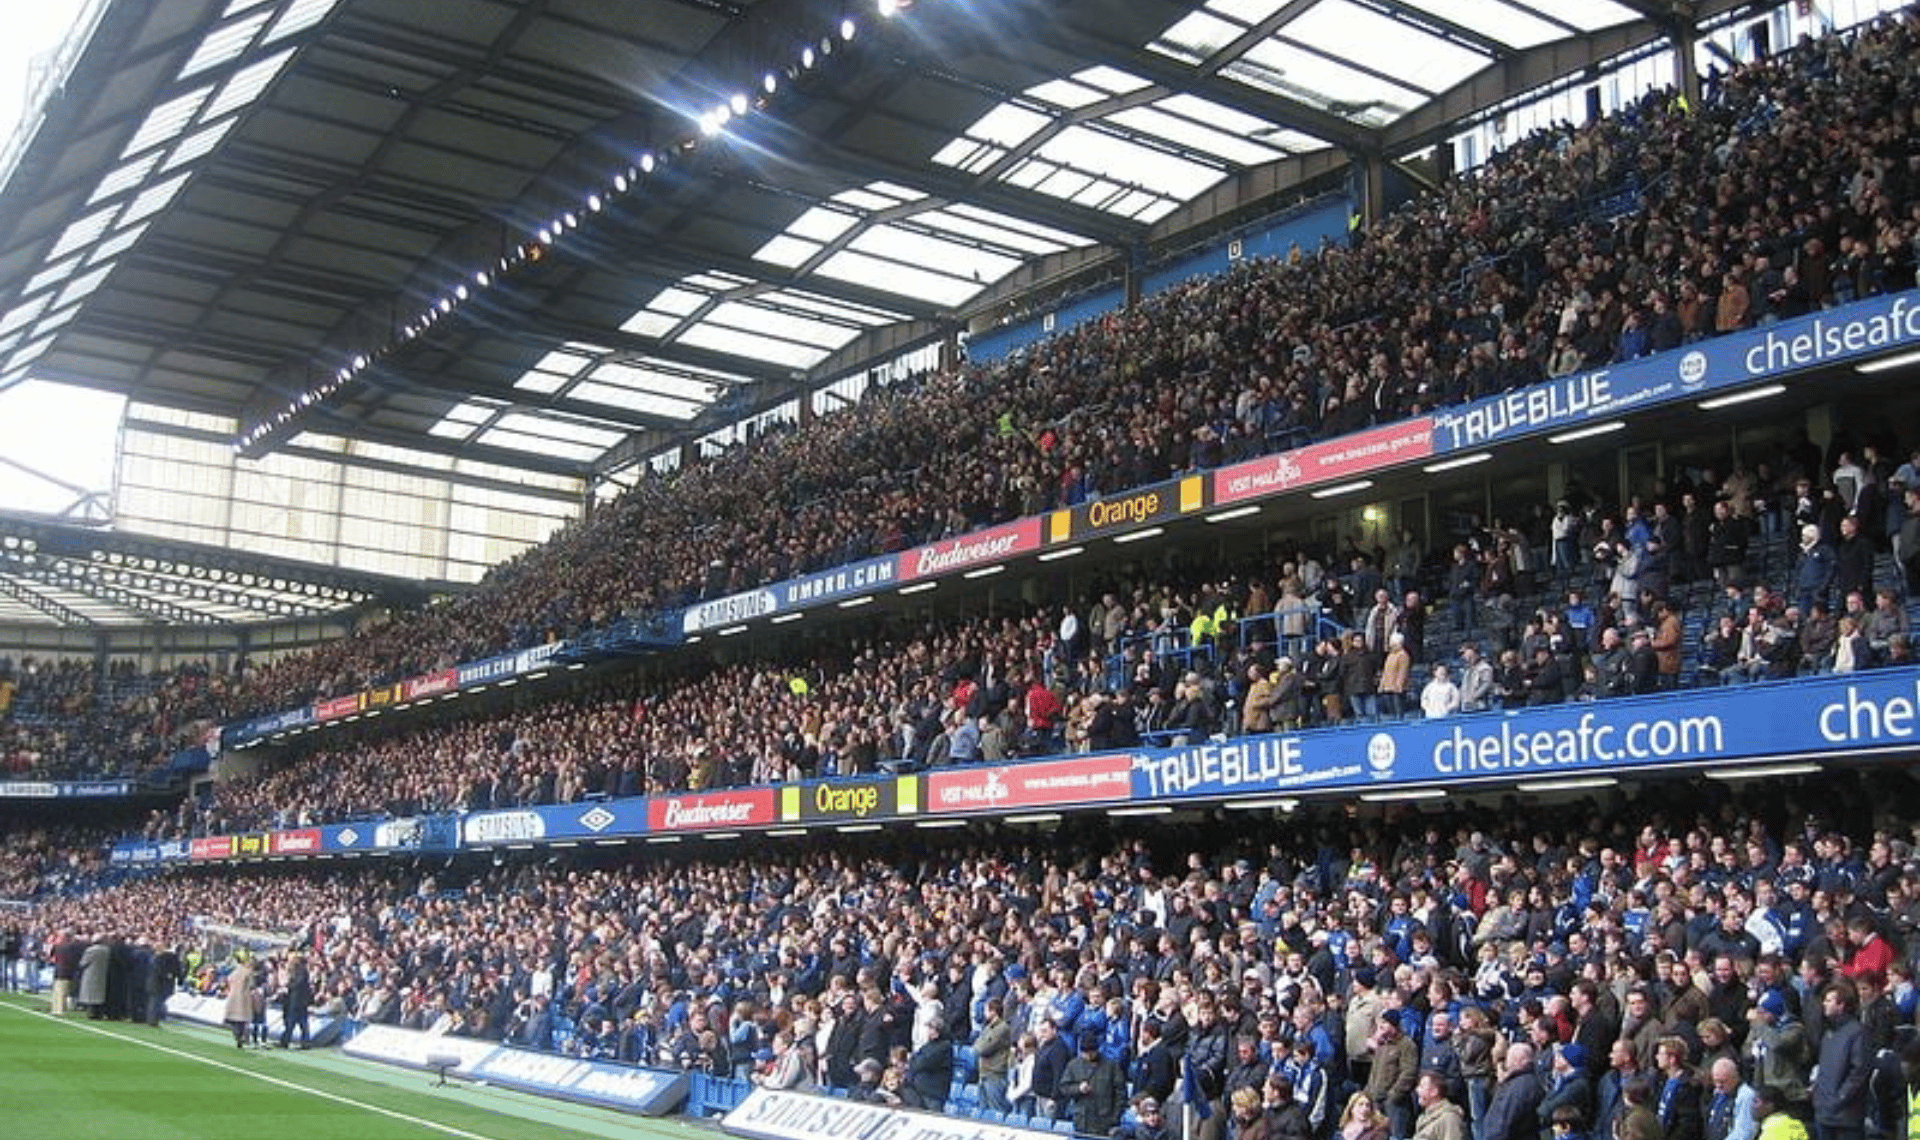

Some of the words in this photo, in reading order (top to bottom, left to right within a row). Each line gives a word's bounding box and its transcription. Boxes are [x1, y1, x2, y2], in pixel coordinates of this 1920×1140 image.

[1448, 369, 1612, 449] TRUEBLUE
[1089, 491, 1158, 527] Orange
[916, 533, 1019, 575] Budweiser
[788, 560, 893, 603] UMBRO.COM
[699, 590, 767, 630] SAMSUNG
[1433, 713, 1724, 773] chelseafc.com
[1144, 737, 1303, 797] TRUEBLUE
[664, 799, 755, 828] Budweiser
[816, 783, 878, 817] Orange
[745, 1094, 910, 1140] SAMSUNG
